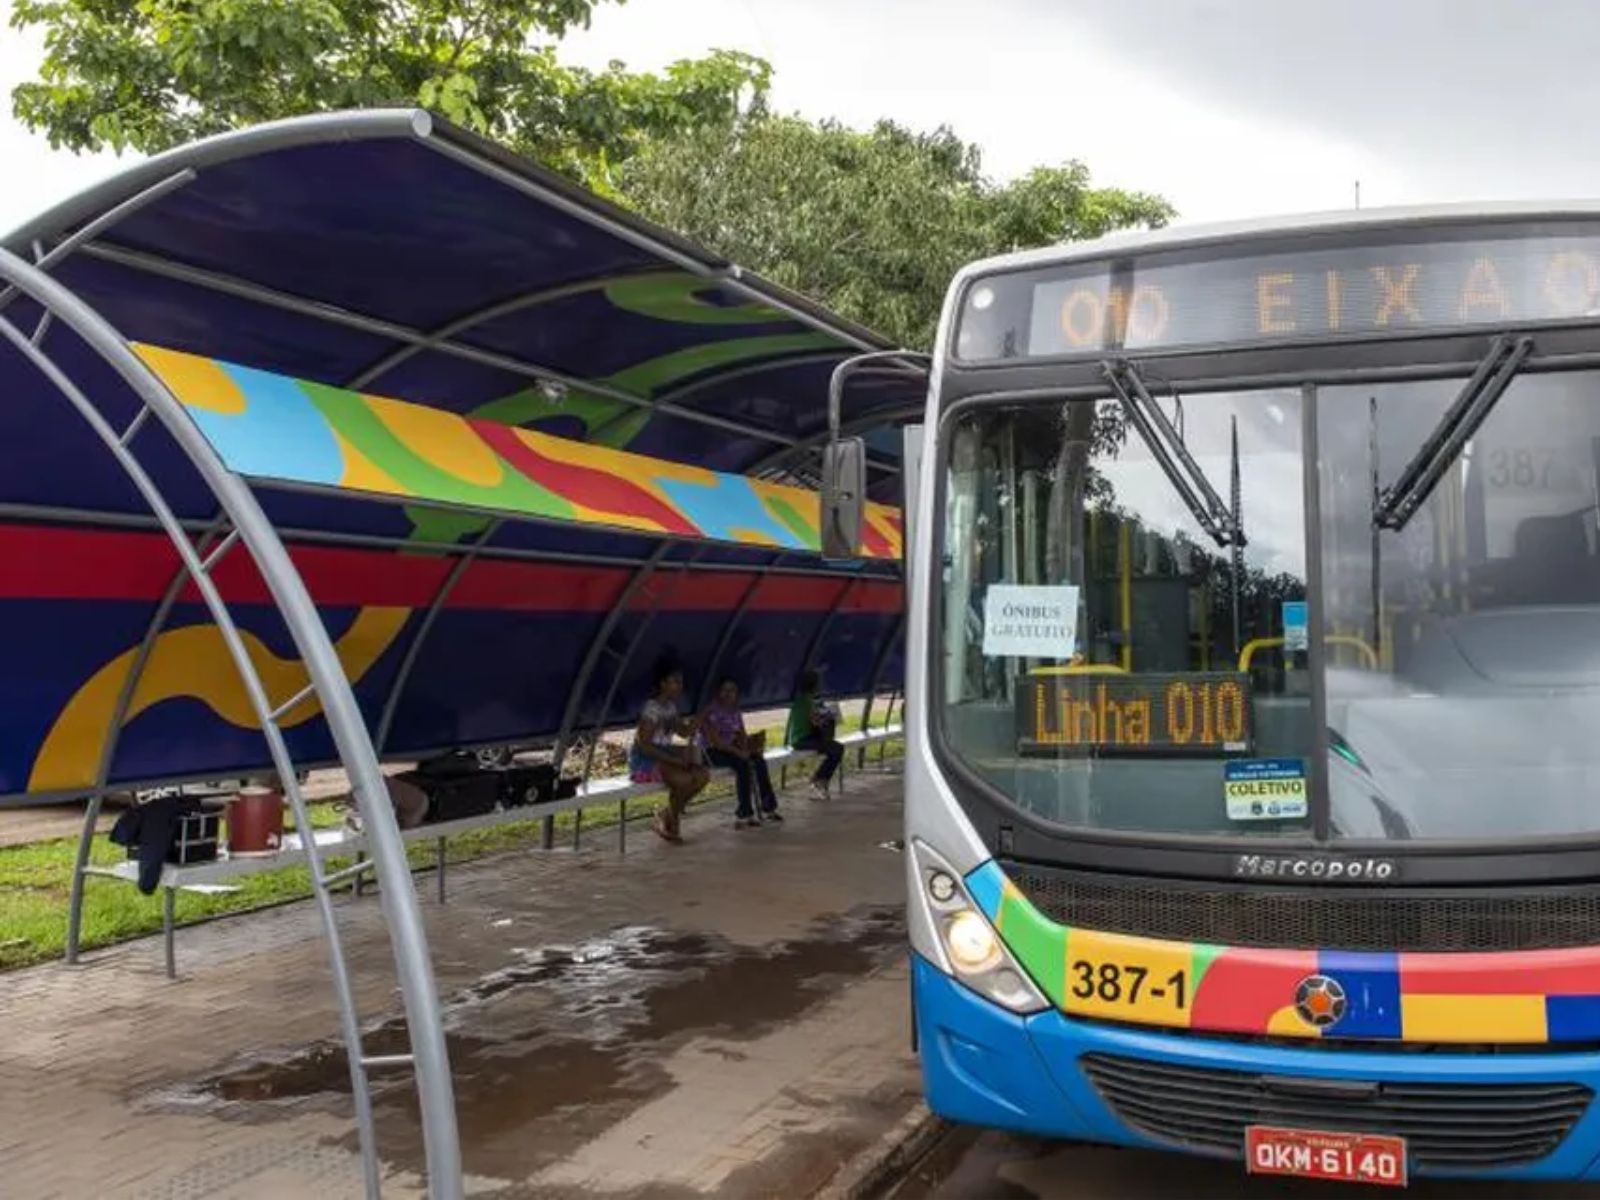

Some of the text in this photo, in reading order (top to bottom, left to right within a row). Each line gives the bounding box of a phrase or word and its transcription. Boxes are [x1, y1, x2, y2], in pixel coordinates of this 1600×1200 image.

[1489, 448, 1553, 488] 387
[1036, 680, 1243, 745] Linha 010
[1229, 781, 1302, 796] COLETIVO
[1235, 855, 1393, 878] Marcopolo
[1072, 960, 1185, 1009] 387-1
